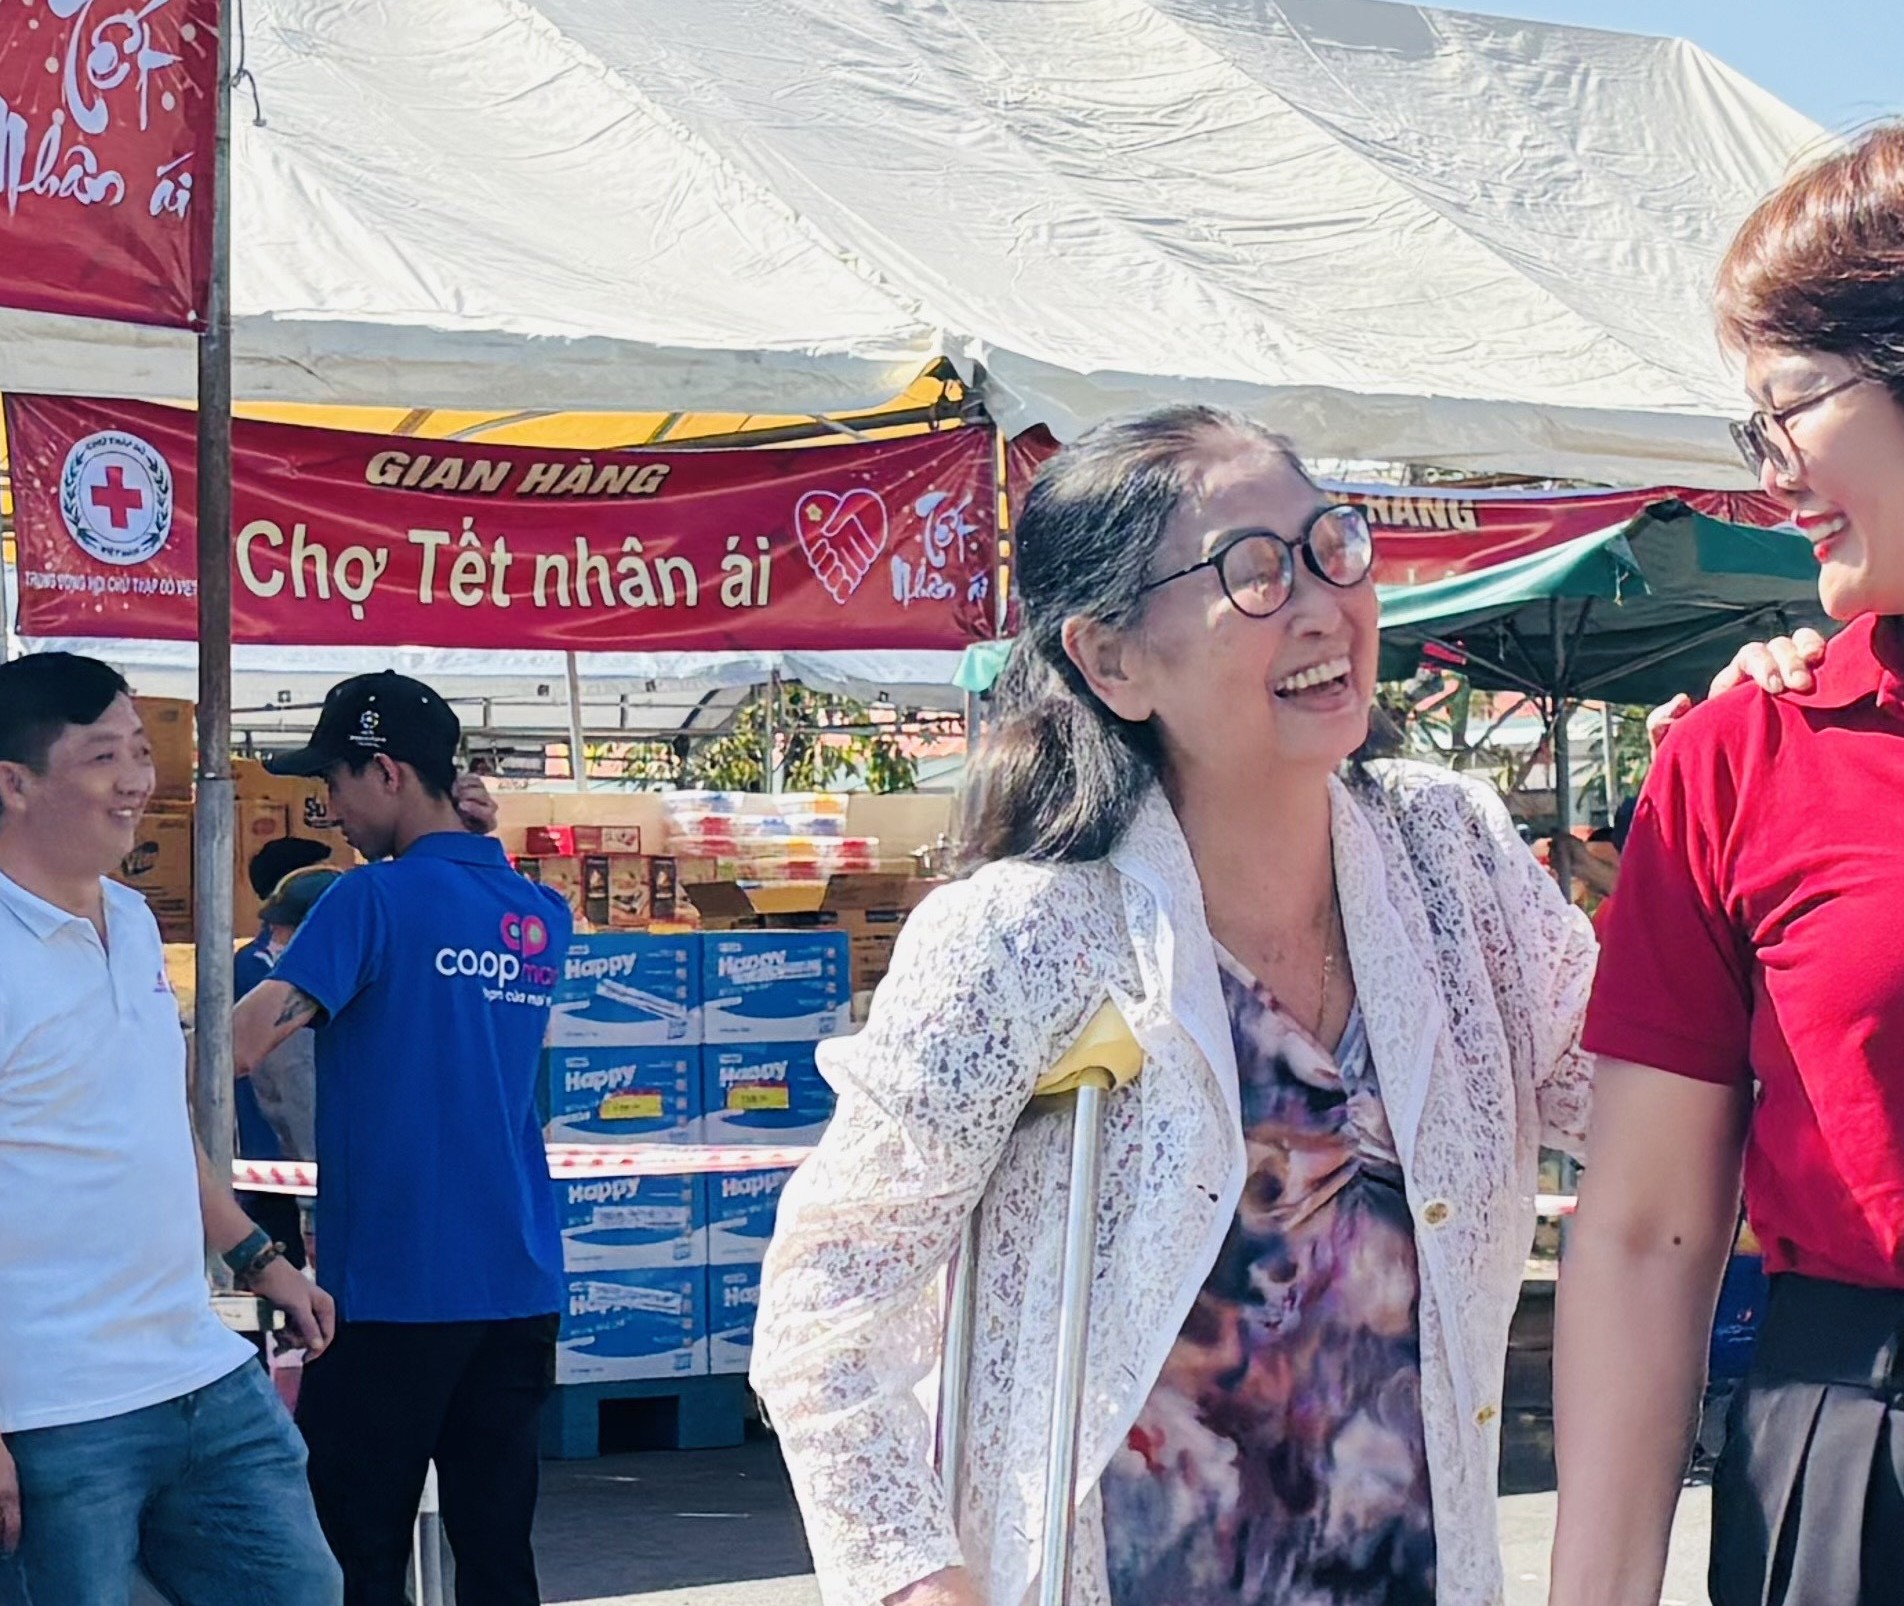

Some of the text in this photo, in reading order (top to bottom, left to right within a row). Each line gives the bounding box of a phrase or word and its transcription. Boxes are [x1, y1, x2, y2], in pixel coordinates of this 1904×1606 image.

[365, 451, 673, 497] GIAN HÀNG
[235, 515, 774, 621] Chợ Tết nhân ái
[564, 952, 637, 986] Happy
[564, 1064, 637, 1093] Happy
[568, 1176, 640, 1204] Happy
